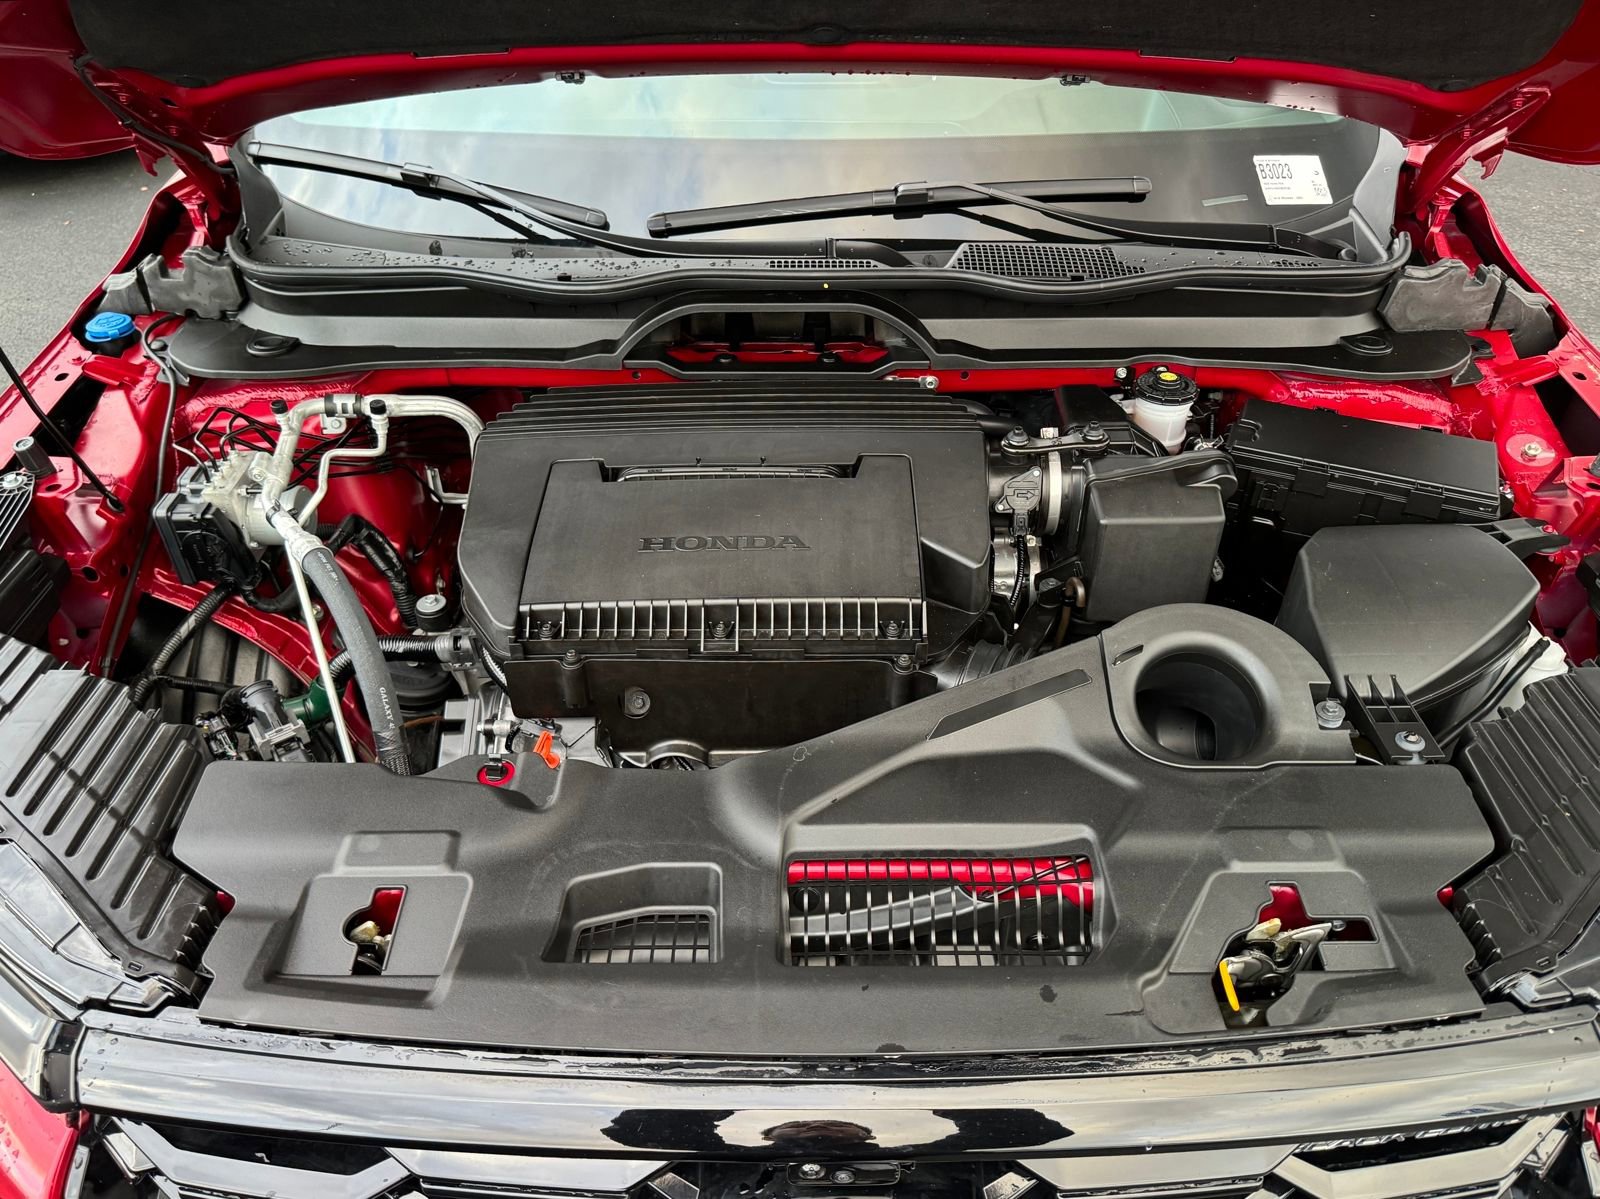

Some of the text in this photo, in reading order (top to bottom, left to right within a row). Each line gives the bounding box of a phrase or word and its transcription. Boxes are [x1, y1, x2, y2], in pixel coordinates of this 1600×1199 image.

[1258, 163, 1293, 179] B3023
[638, 535, 811, 553] HONDA
[380, 687, 394, 721] GALAXY
